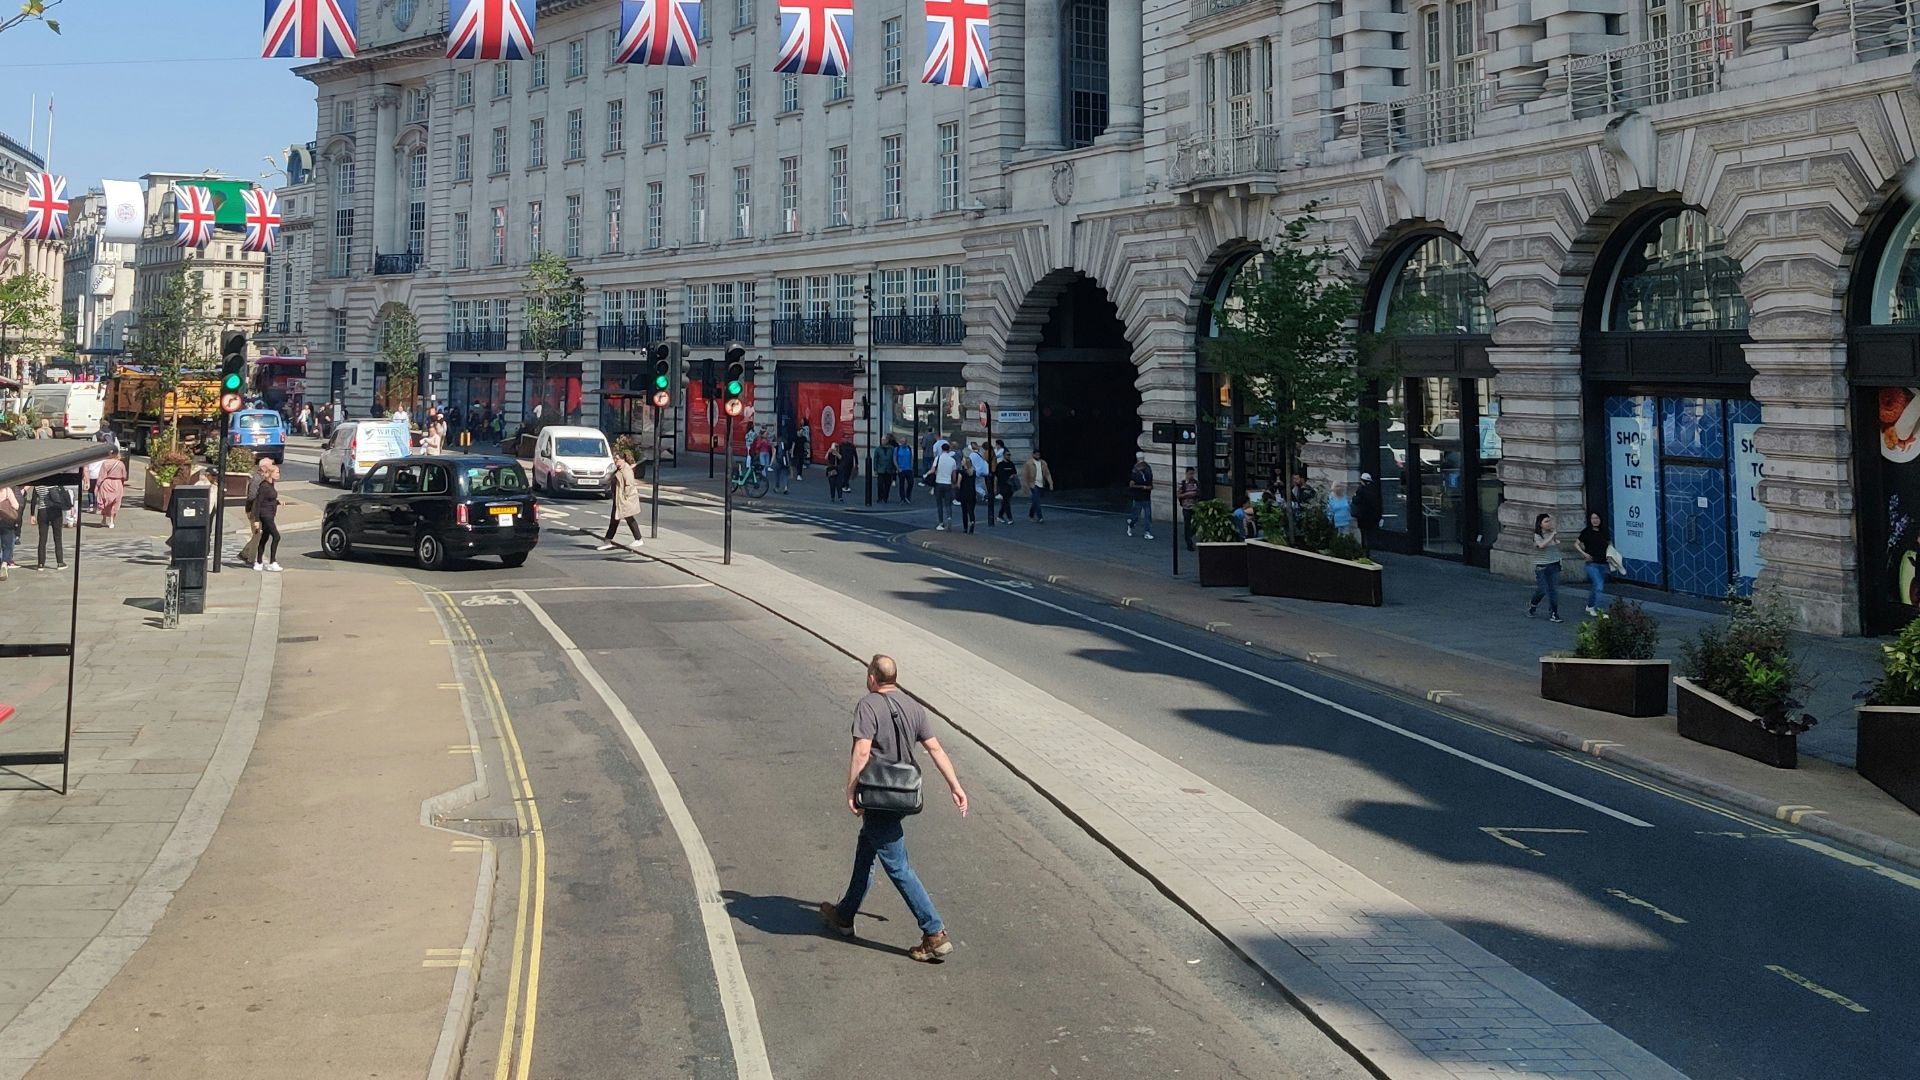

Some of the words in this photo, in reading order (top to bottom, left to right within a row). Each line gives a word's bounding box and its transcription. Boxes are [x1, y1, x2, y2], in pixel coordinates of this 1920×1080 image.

[1616, 432, 1647, 446] SHOP
[1625, 453, 1640, 467] TO
[1625, 475, 1642, 489] LET
[1629, 506, 1640, 519] 69
[1626, 521, 1645, 529] REGENT
[1627, 530, 1644, 538] STREET
